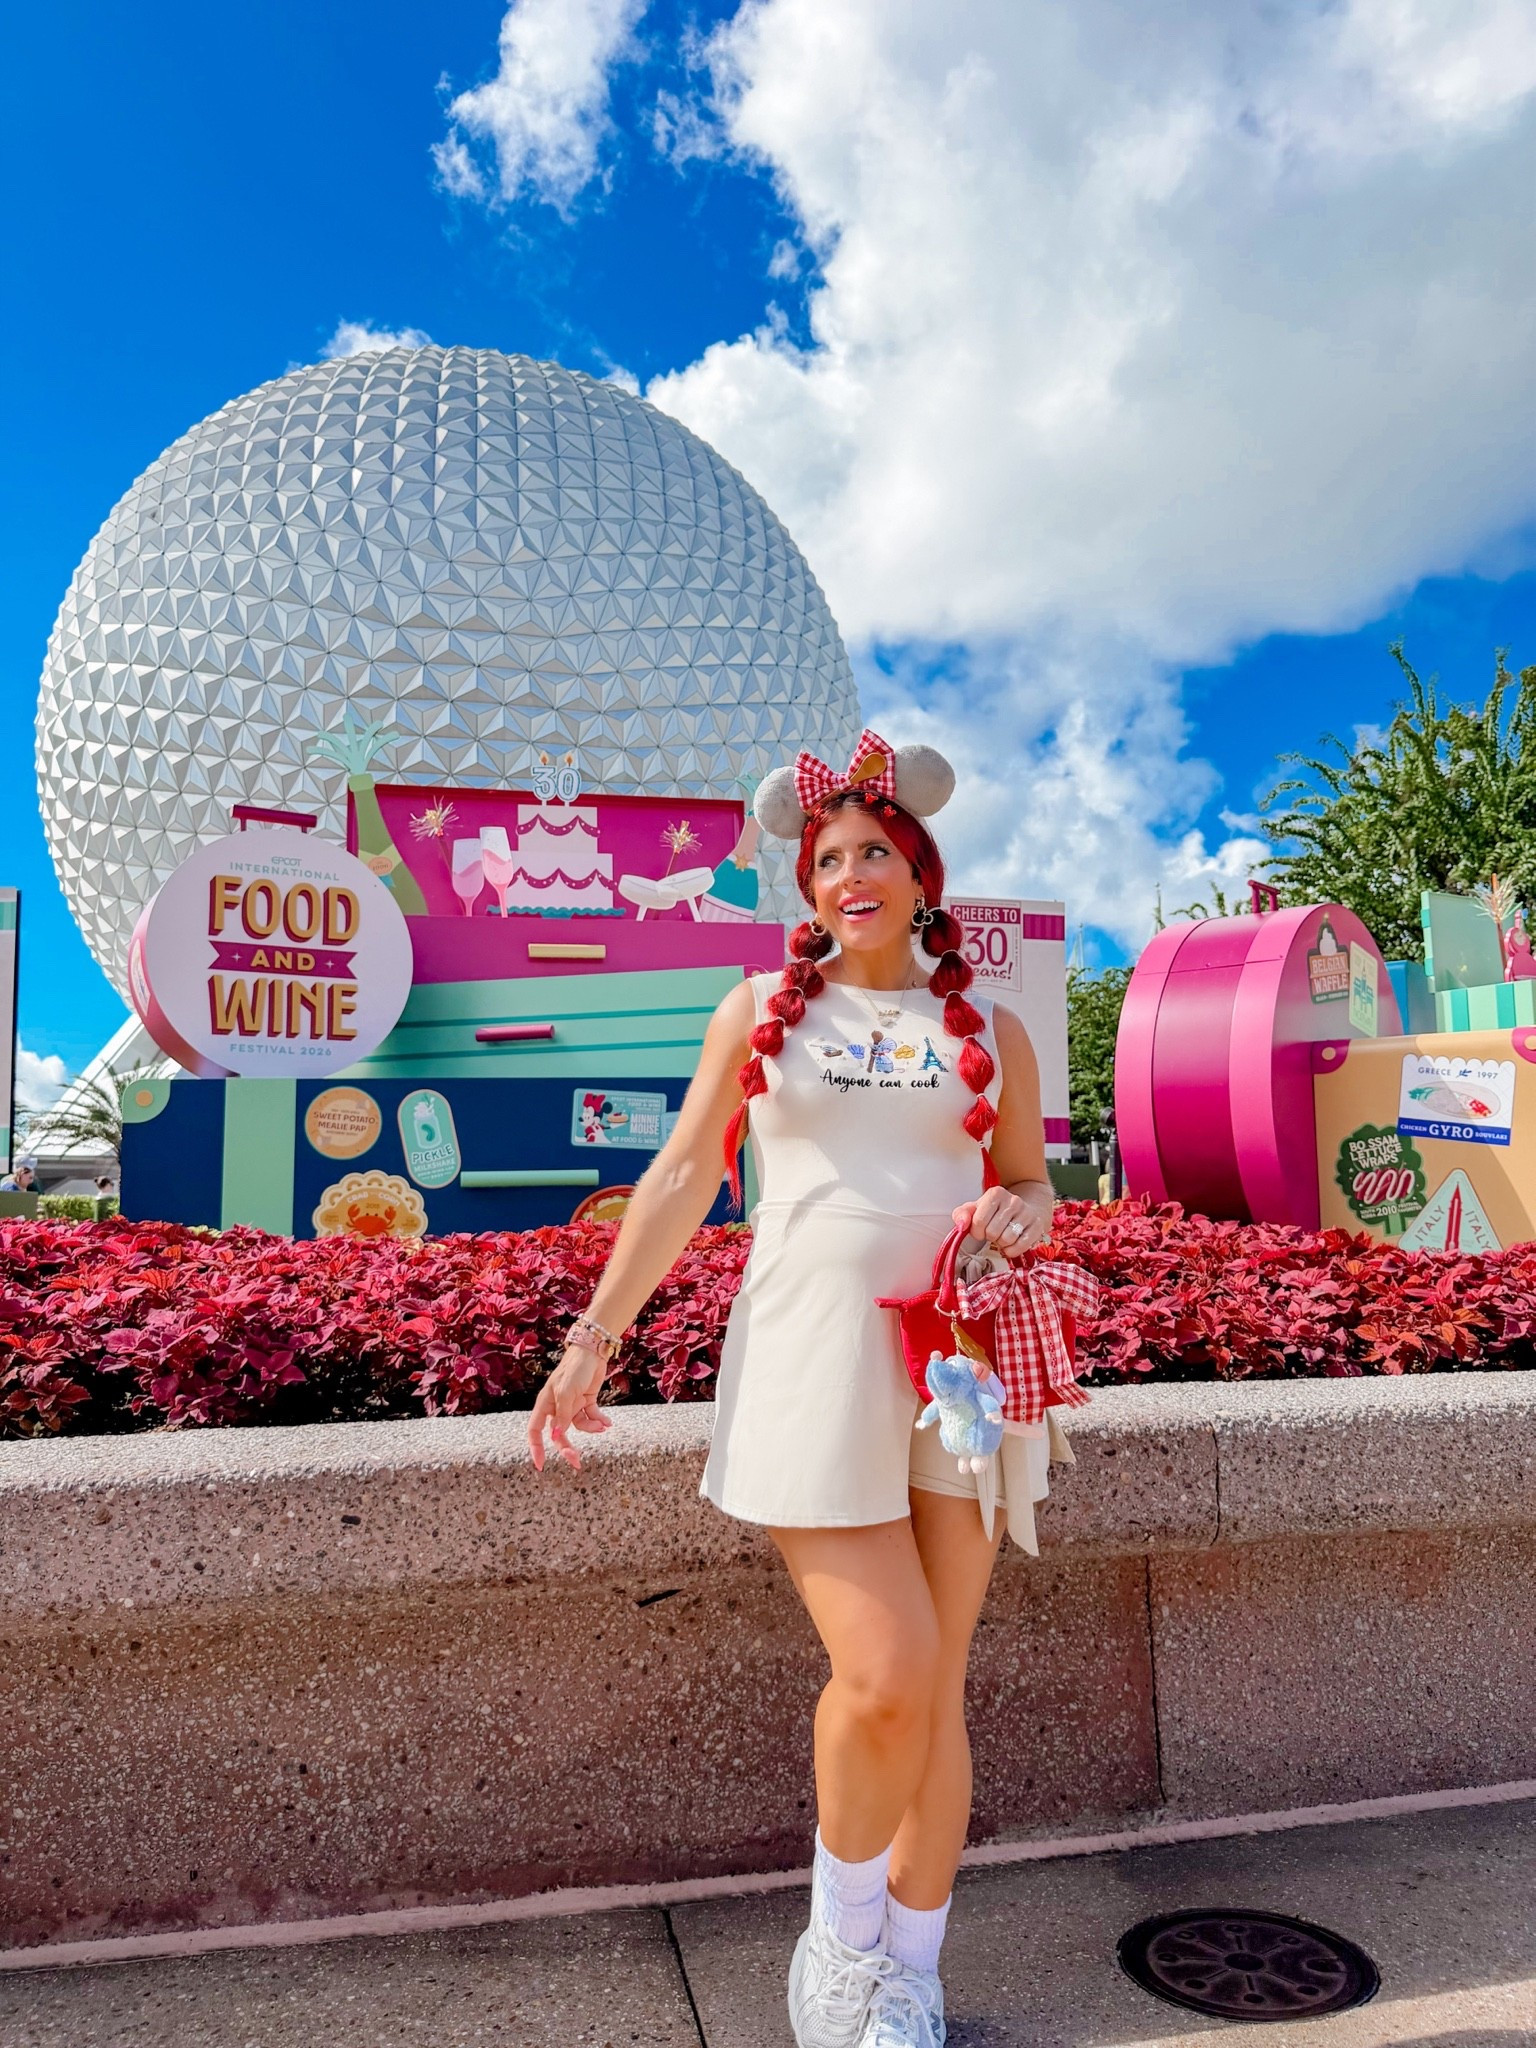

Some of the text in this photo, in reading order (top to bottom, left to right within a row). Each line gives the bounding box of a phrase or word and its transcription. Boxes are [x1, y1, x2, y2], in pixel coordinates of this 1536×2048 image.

[532, 765, 581, 801] 30
[271, 856, 302, 867] EPCOT
[230, 862, 340, 881] INTERNATIONAL
[208, 875, 361, 946] FOOD
[953, 906, 1018, 923] CHEERS TO
[964, 927, 1008, 966] 30
[251, 949, 316, 971] AND
[1311, 956, 1347, 974] BELGIAN
[973, 962, 1013, 980] ears!
[1313, 974, 1348, 994] WAFFLE
[207, 975, 359, 1042] WINE
[230, 1043, 332, 1056] FESTIVAL 2026
[820, 1068, 940, 1093] Anyone can cook
[1418, 1066, 1499, 1079] GREECE 1997
[313, 1111, 343, 1120] SWEET
[343, 1114, 376, 1125] POTATO
[318, 1121, 367, 1132] MEALIE PAP
[630, 1113, 660, 1124] MINNIE
[630, 1122, 660, 1135] MOUSE
[1400, 1123, 1508, 1140] CHICKEN GYRO SOUVLAKI
[1349, 1134, 1399, 1152] BO SSAM
[1349, 1142, 1403, 1161] LETTUCE
[412, 1144, 454, 1163] PICKLE
[1359, 1153, 1399, 1169] WRAPS
[414, 1158, 456, 1172] MILKSHAKE
[1376, 1205, 1397, 1216] 2010
[1415, 1205, 1445, 1242] ITALY
[1465, 1210, 1492, 1250] ITALY
